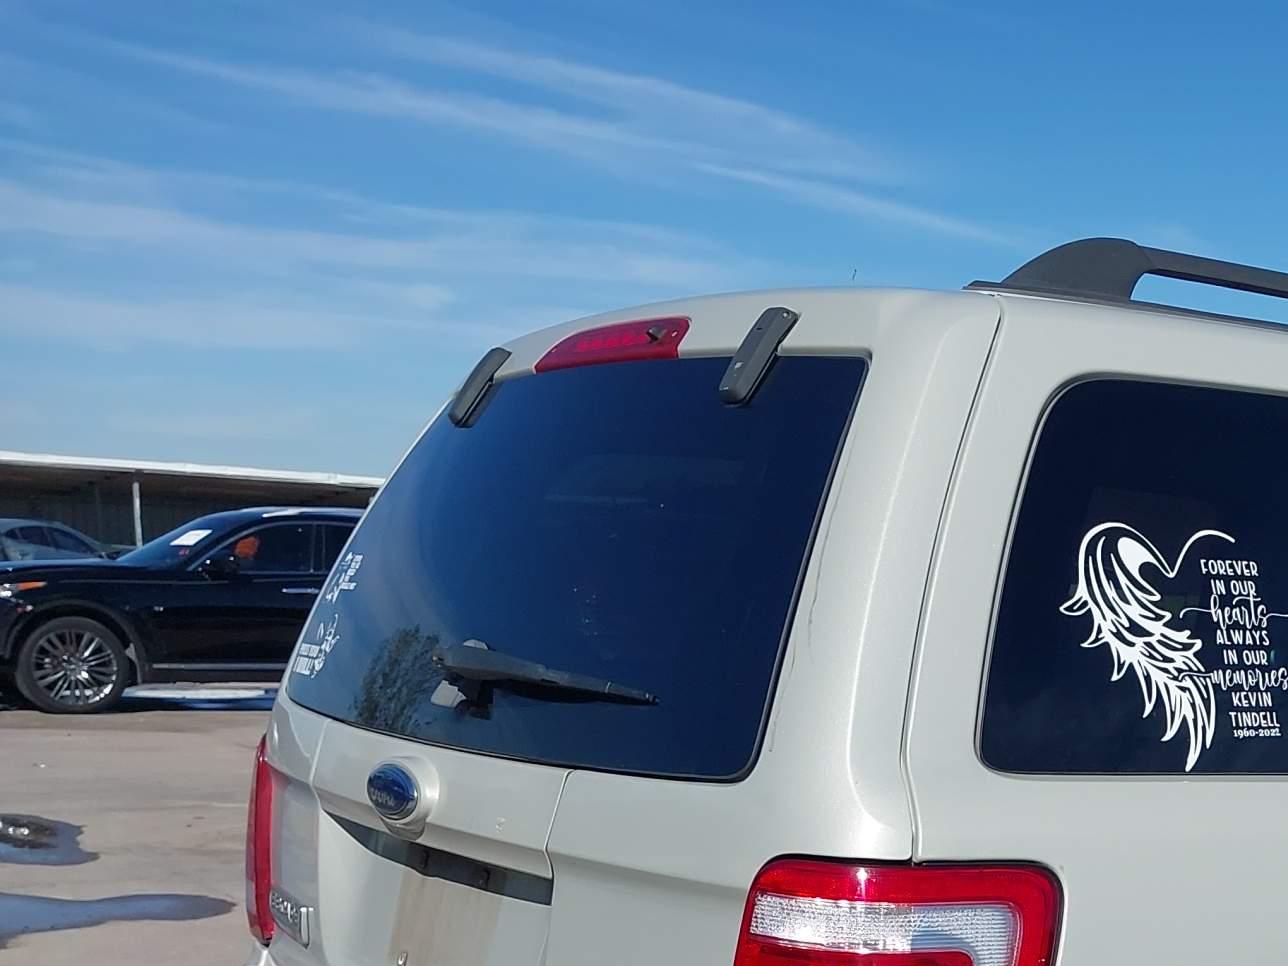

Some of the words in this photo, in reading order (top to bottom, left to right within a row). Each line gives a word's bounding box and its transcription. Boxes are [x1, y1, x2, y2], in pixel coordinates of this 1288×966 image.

[1200, 559, 1258, 576] FOREVER
[1211, 579, 1225, 595] IN
[1231, 580, 1256, 597] OUR
[1216, 629, 1270, 646] ALWAYS
[1223, 649, 1238, 665] IN
[1243, 650, 1268, 666] OUR
[1232, 691, 1272, 707] KEVIN
[1228, 711, 1280, 727] TINDELL
[1233, 727, 1281, 738] 1960-2022
